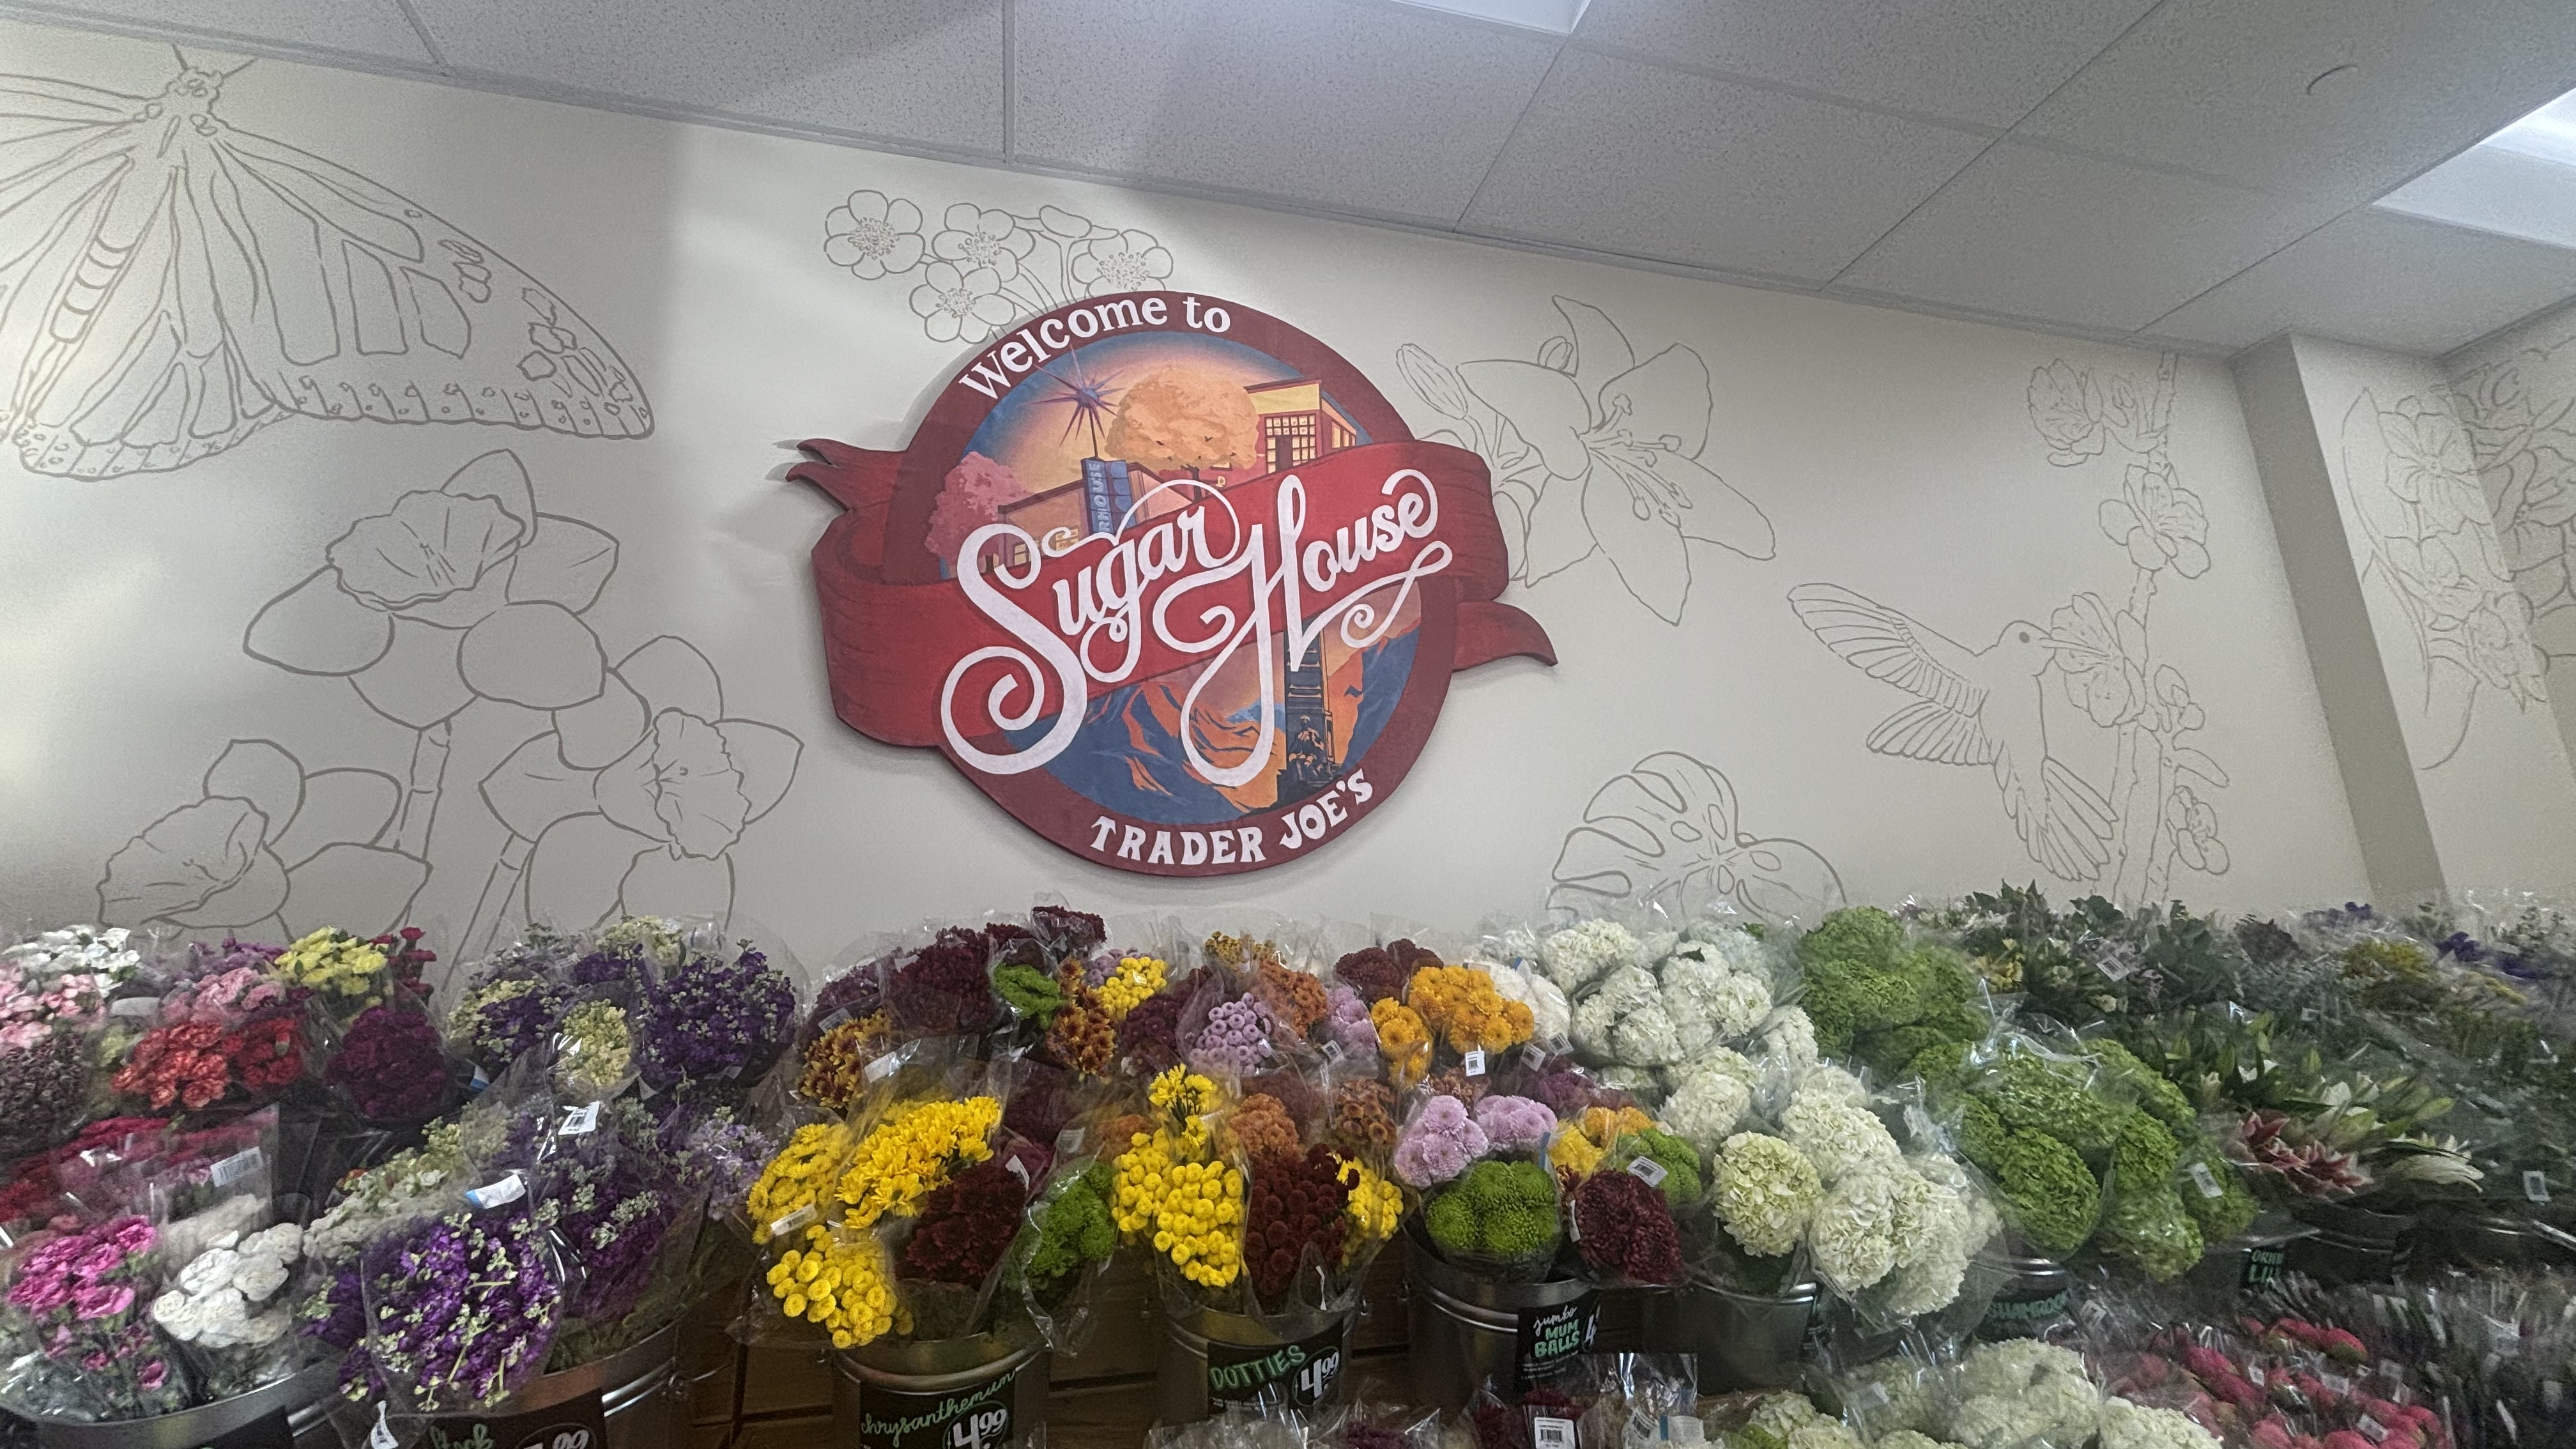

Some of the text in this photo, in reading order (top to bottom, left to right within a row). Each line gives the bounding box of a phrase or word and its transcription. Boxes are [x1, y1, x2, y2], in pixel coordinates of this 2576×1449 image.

[959, 296, 1230, 399] Welcome to
[940, 469, 1452, 786] Sugar House
[1090, 768, 1373, 865] TRADER JOE'S
[1210, 1344, 1307, 1391] DOTTIES
[1534, 1330, 1580, 1358] BALLS
[1545, 1319, 1579, 1340] MUM
[861, 1370, 1015, 1448] chrysanthemum
